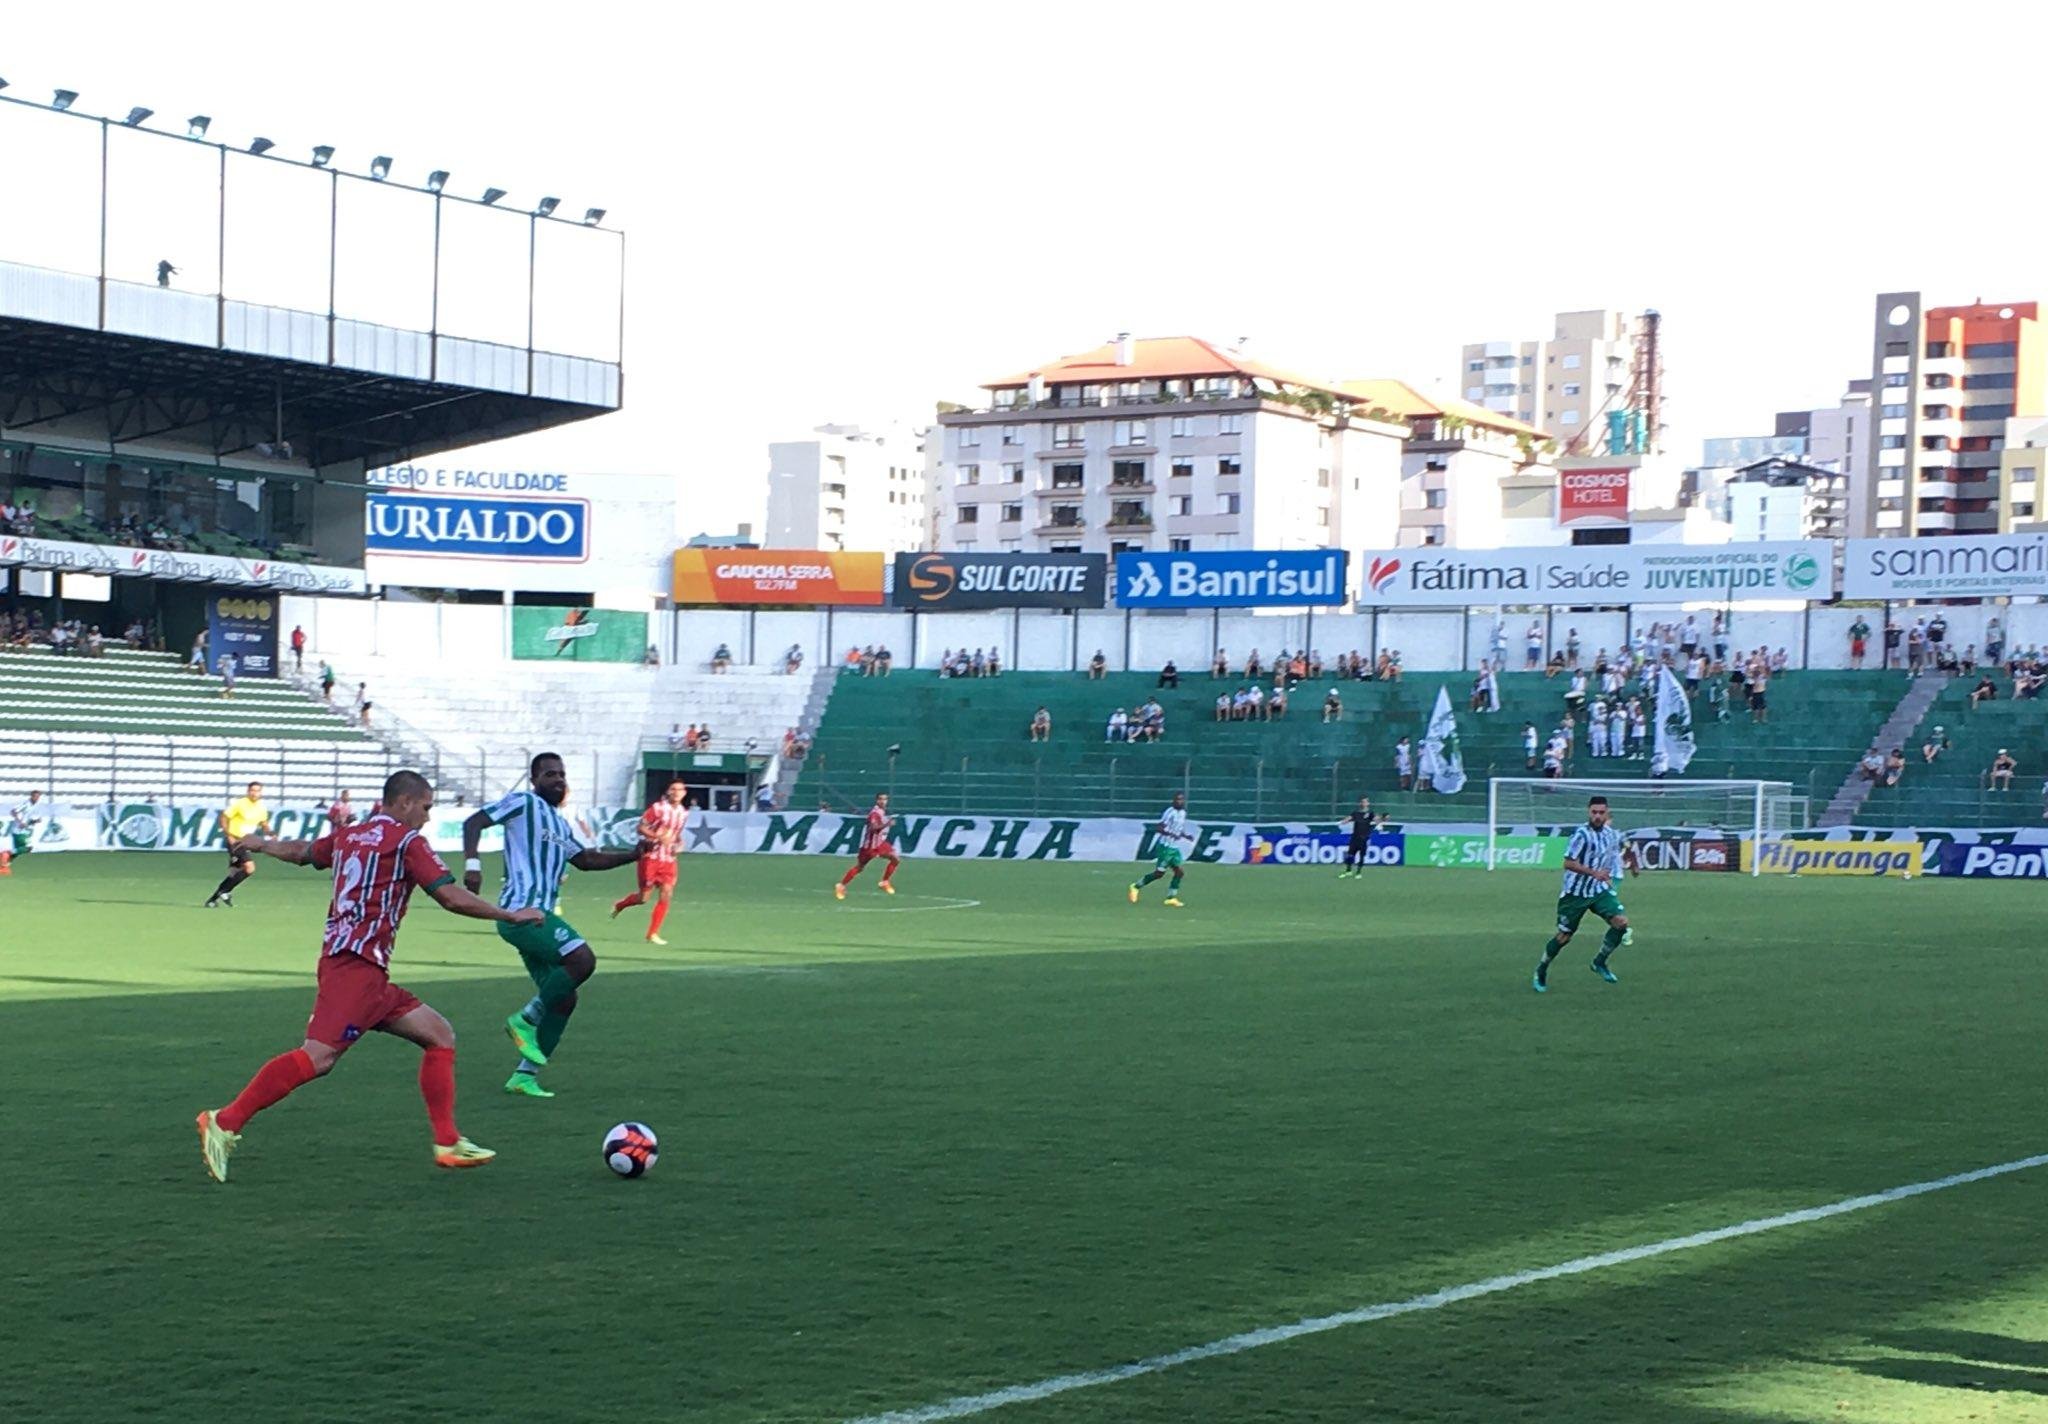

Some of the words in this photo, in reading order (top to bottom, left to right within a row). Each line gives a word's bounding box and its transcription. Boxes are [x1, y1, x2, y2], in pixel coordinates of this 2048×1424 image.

[436, 469, 446, 487] E
[454, 470, 568, 491] FACULDADE
[1565, 473, 1626, 488] COSMOS
[1573, 489, 1616, 503] HOTEL
[1715, 554, 1759, 565] OFICIAL
[1761, 553, 1779, 564] DO
[1870, 536, 2048, 577] sanmari
[787, 565, 834, 579] SERRA
[1169, 557, 1335, 597] Banrisul
[1410, 558, 1529, 591] fátima
[1546, 563, 1630, 589] Saúde
[1645, 568, 1776, 589] JUVENTUDE
[755, 815, 1081, 860] MANCHA
[1275, 838, 1400, 864] Colombo
